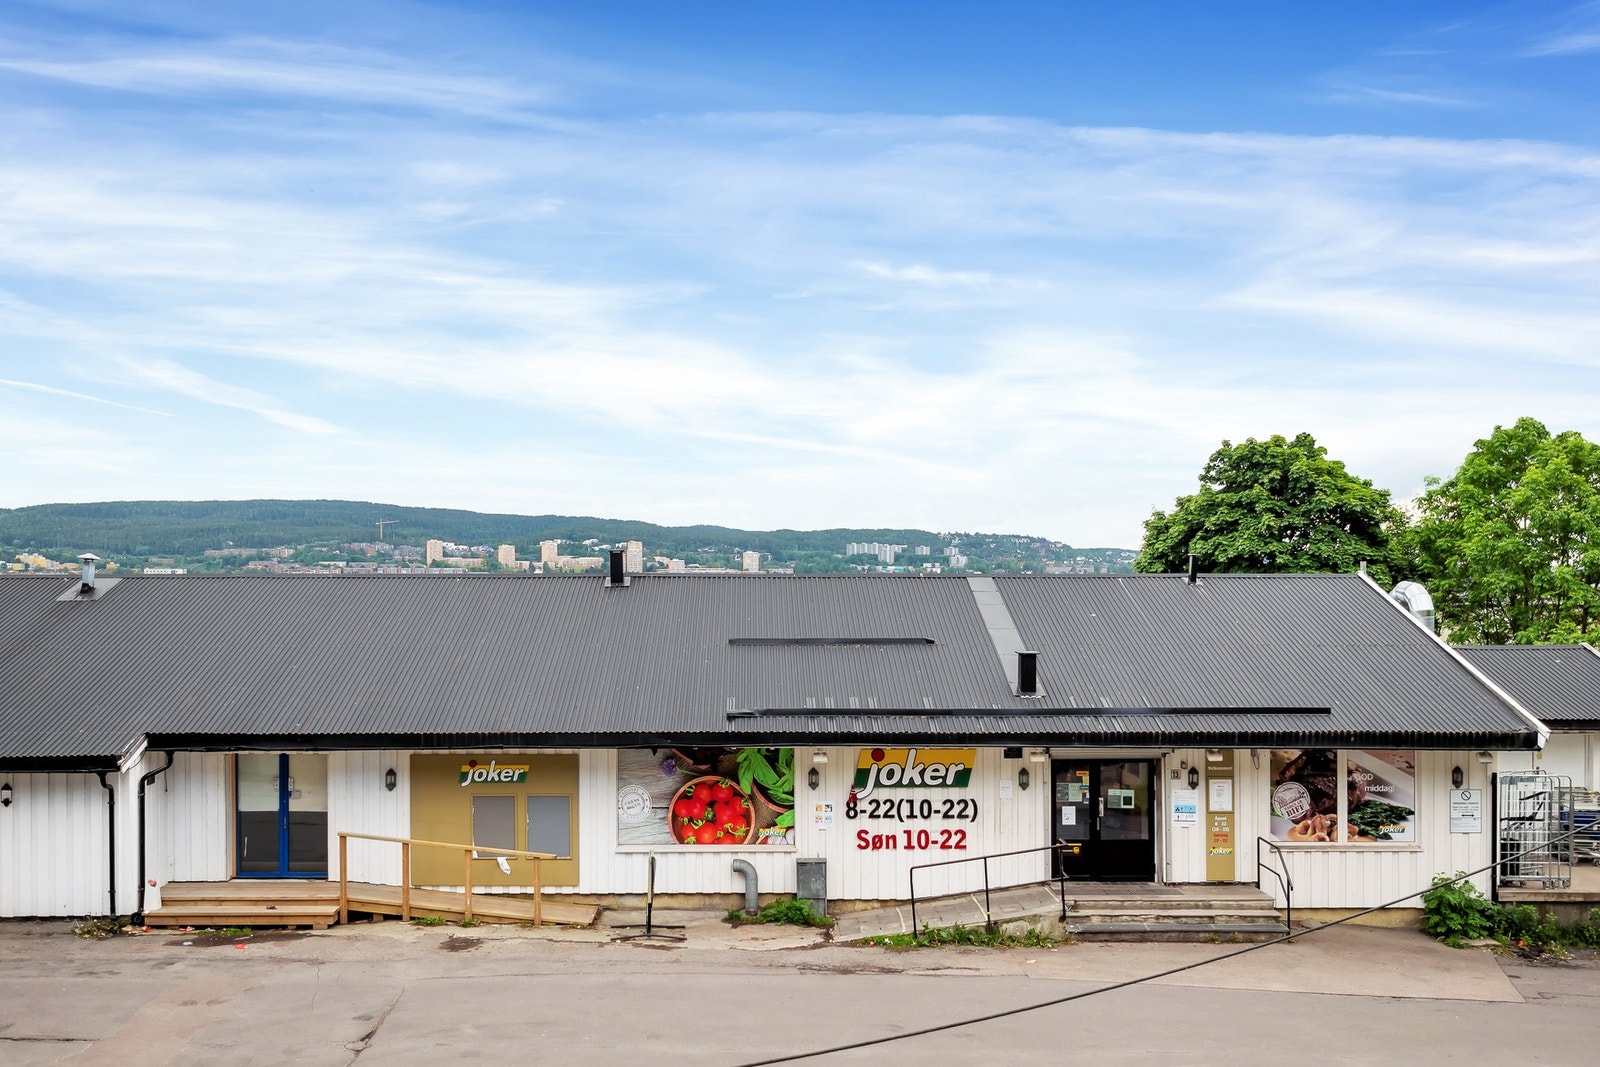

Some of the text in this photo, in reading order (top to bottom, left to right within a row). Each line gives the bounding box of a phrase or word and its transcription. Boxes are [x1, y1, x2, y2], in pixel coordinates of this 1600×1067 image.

[461, 759, 525, 787] joker
[856, 748, 965, 800] joker
[1364, 784, 1396, 794] middag!
[845, 798, 978, 822] 8-22(10-22)
[759, 825, 784, 838] joker
[1379, 823, 1403, 835] joker
[856, 829, 967, 851] Søn 10-22
[1209, 846, 1231, 856] joker
